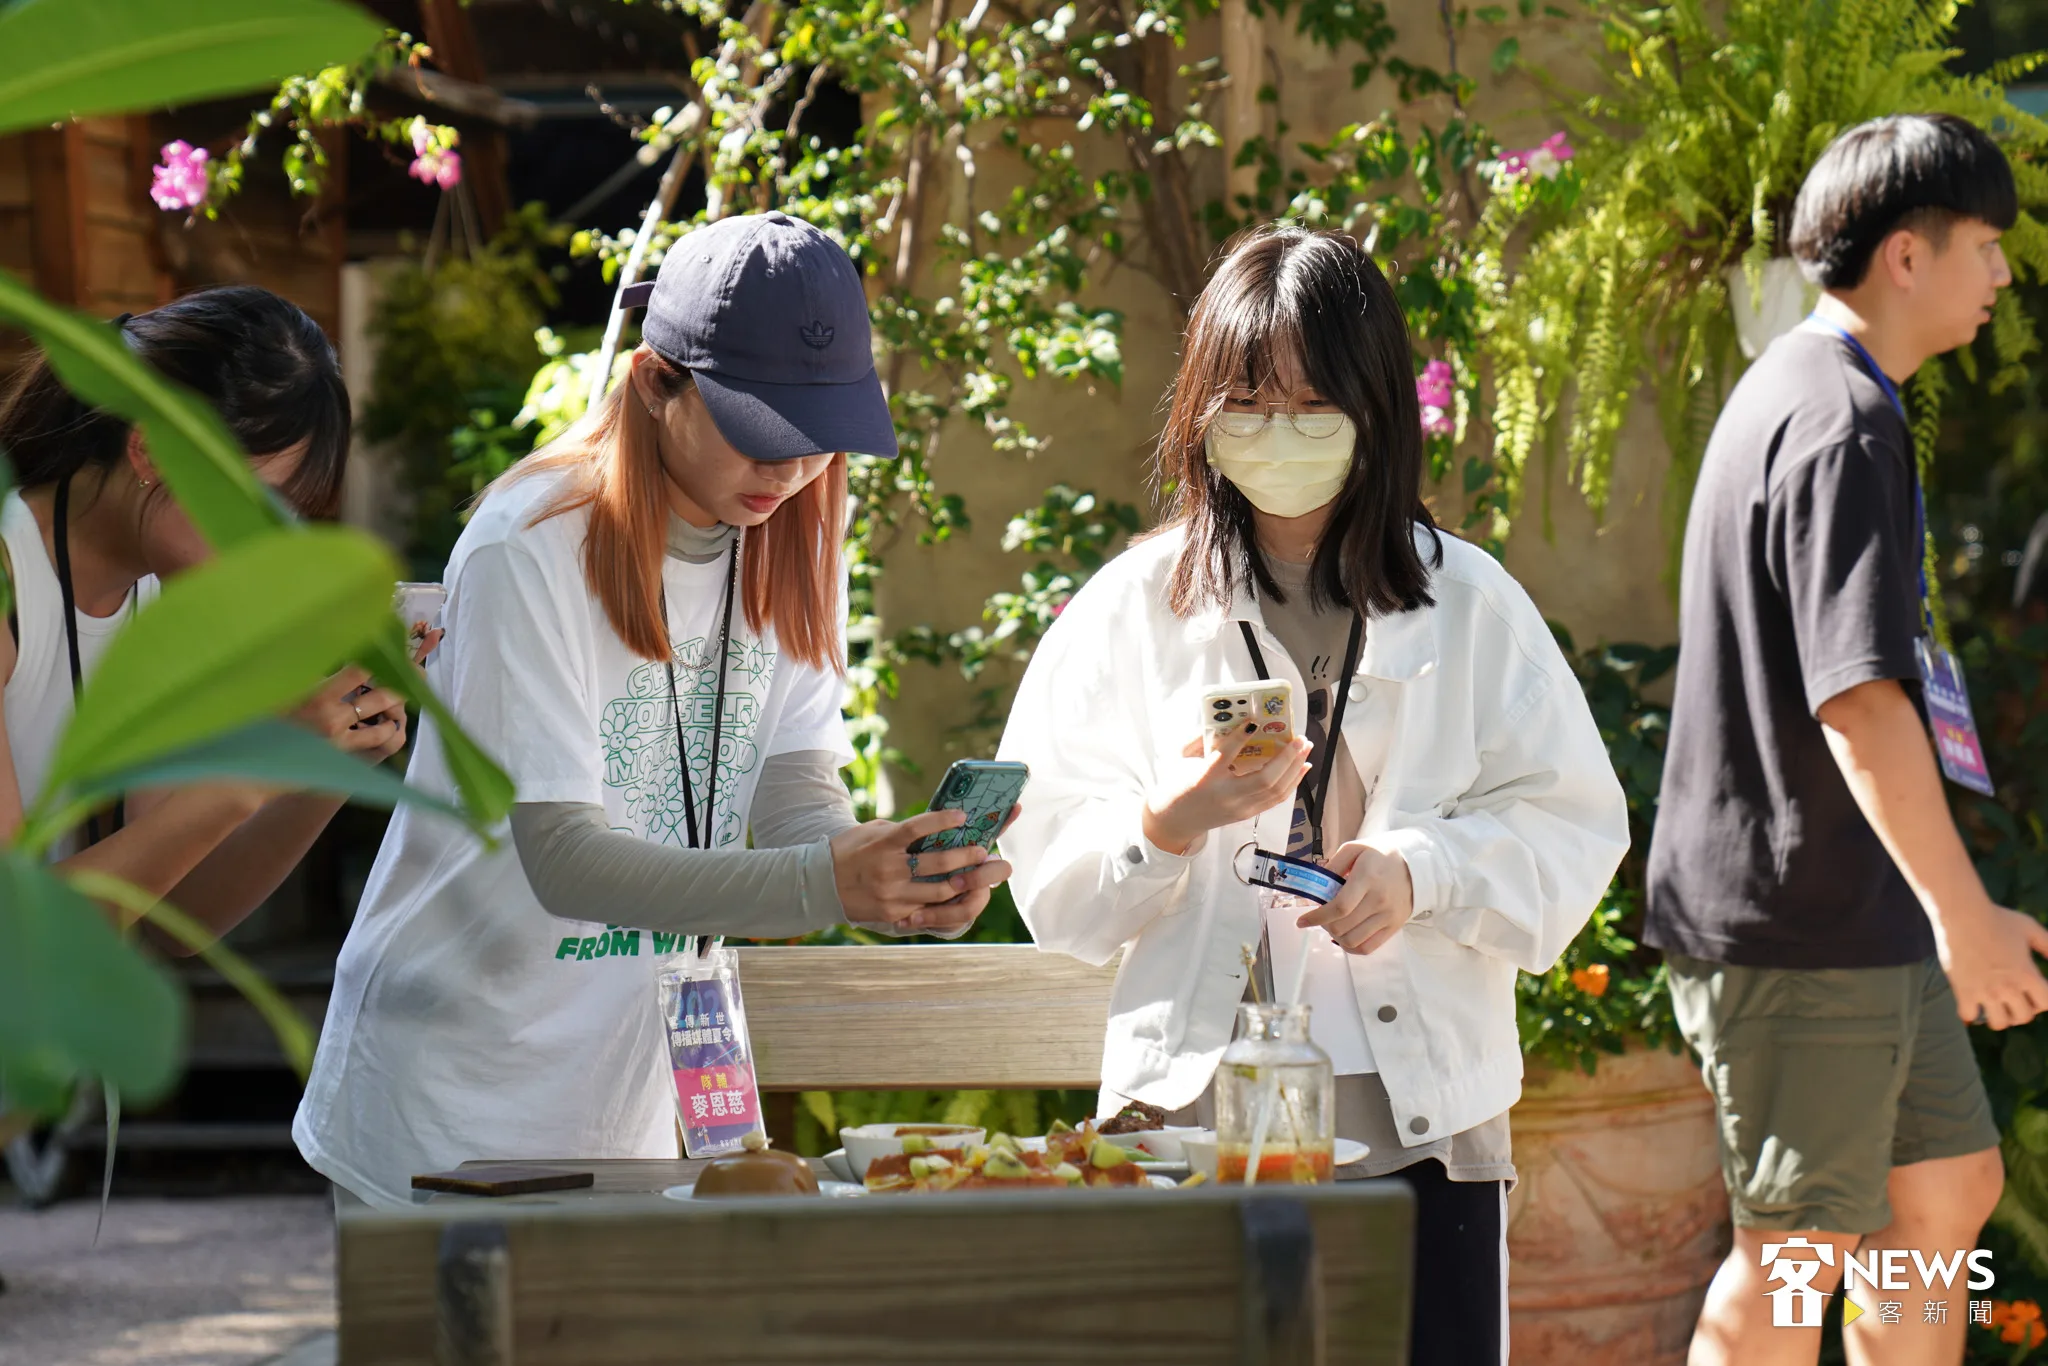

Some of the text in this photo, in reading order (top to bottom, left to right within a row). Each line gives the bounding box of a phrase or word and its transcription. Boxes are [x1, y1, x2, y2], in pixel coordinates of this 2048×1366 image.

[555, 930, 640, 961] FROM
[671, 1026, 733, 1048] 傳播媒體夏令
[690, 1089, 746, 1119] 麥恩慈
